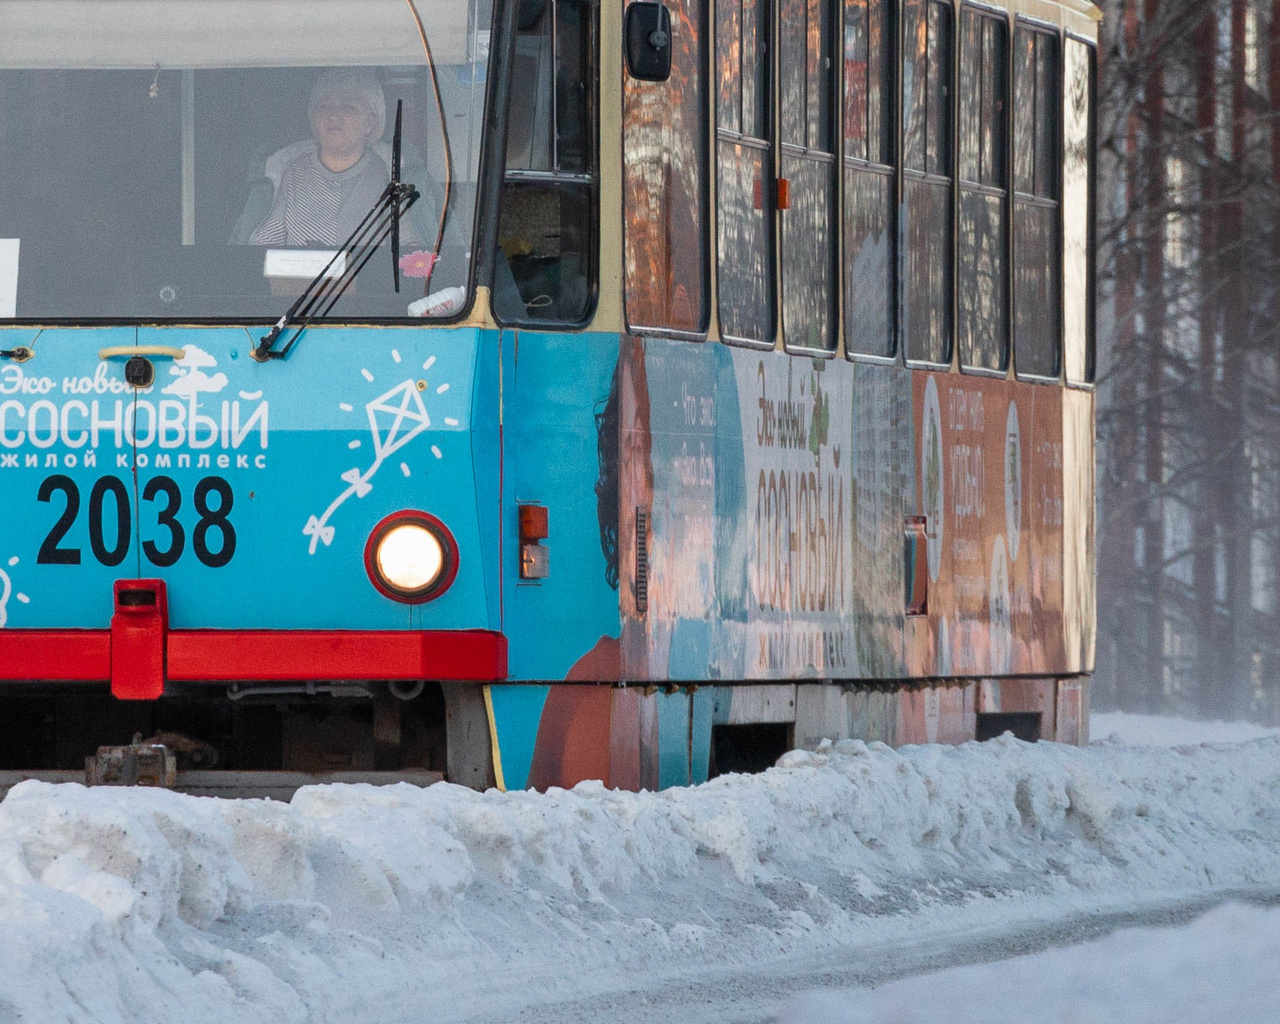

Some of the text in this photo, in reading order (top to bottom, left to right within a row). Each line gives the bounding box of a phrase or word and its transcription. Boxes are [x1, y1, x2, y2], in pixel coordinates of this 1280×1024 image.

[0, 449, 267, 469] жилой комплекс
[36, 473, 237, 568] 2038
[757, 443, 844, 612] СОСНОВЫЙ
